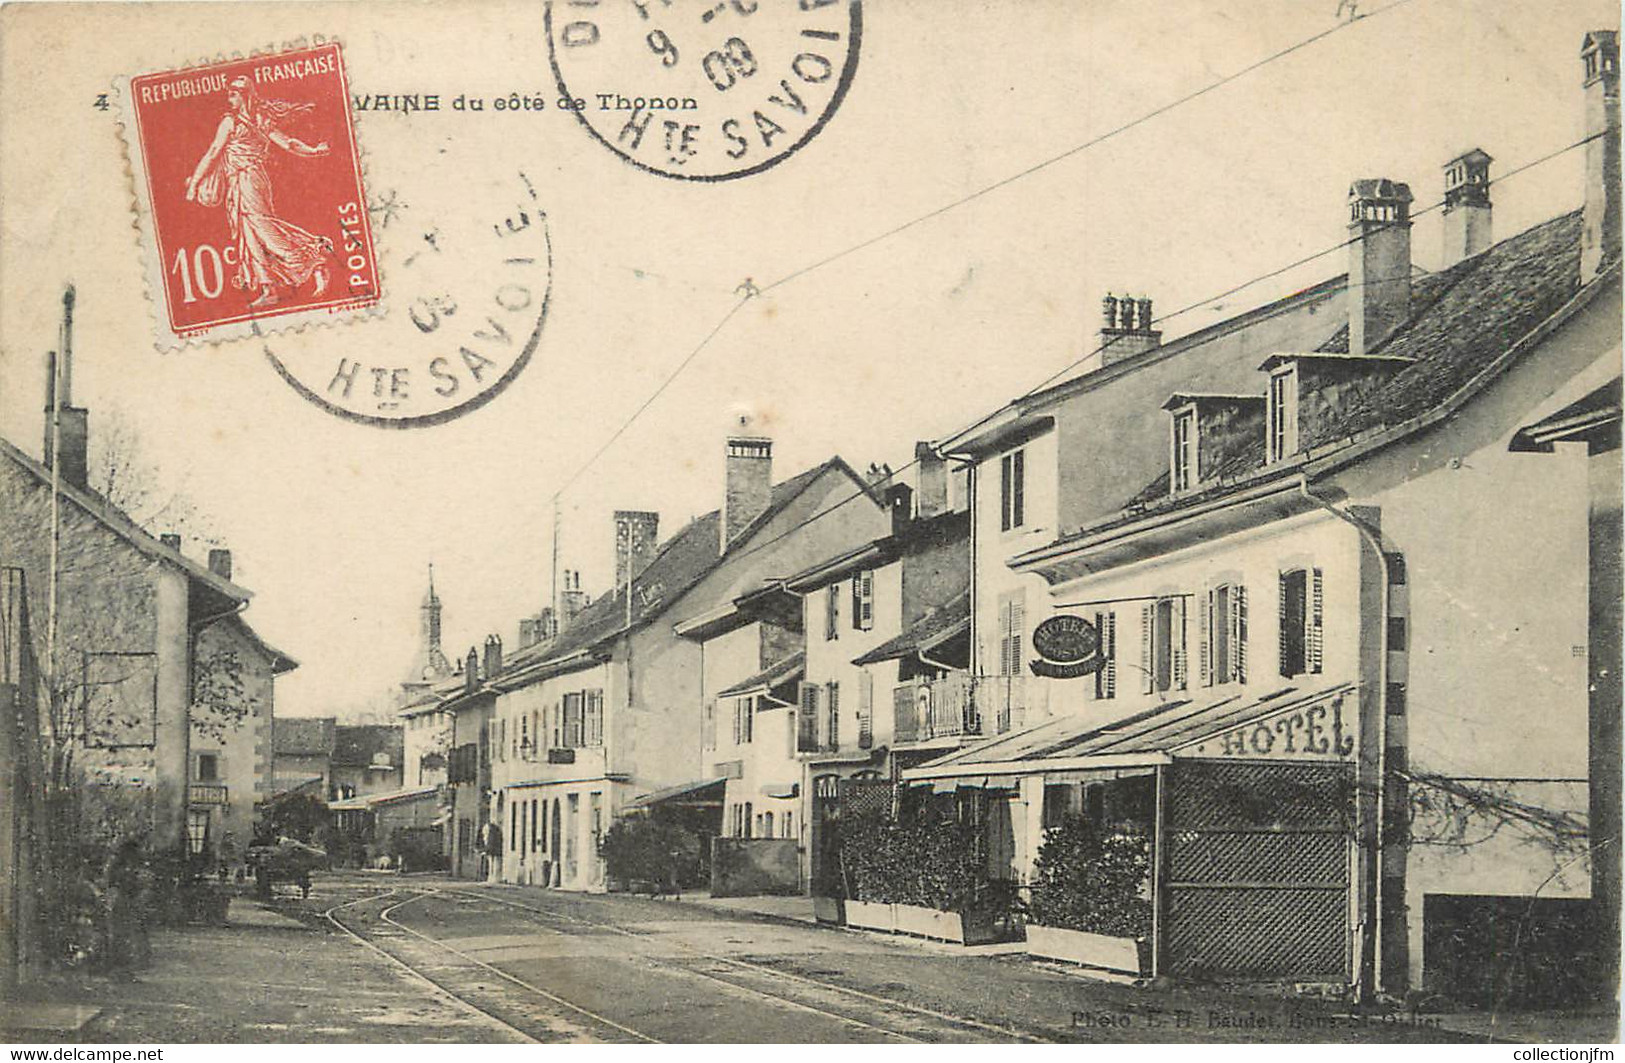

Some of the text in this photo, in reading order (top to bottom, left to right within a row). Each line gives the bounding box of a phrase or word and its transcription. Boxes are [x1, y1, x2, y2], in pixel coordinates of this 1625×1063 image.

[254, 53, 336, 84] FRANÇAISE
[453, 94, 484, 111] du
[494, 92, 546, 111] côté
[557, 94, 587, 111] de
[596, 93, 699, 111] Thonon
[338, 201, 369, 288] POSTES
[1071, 1010, 1131, 1029] Photo
